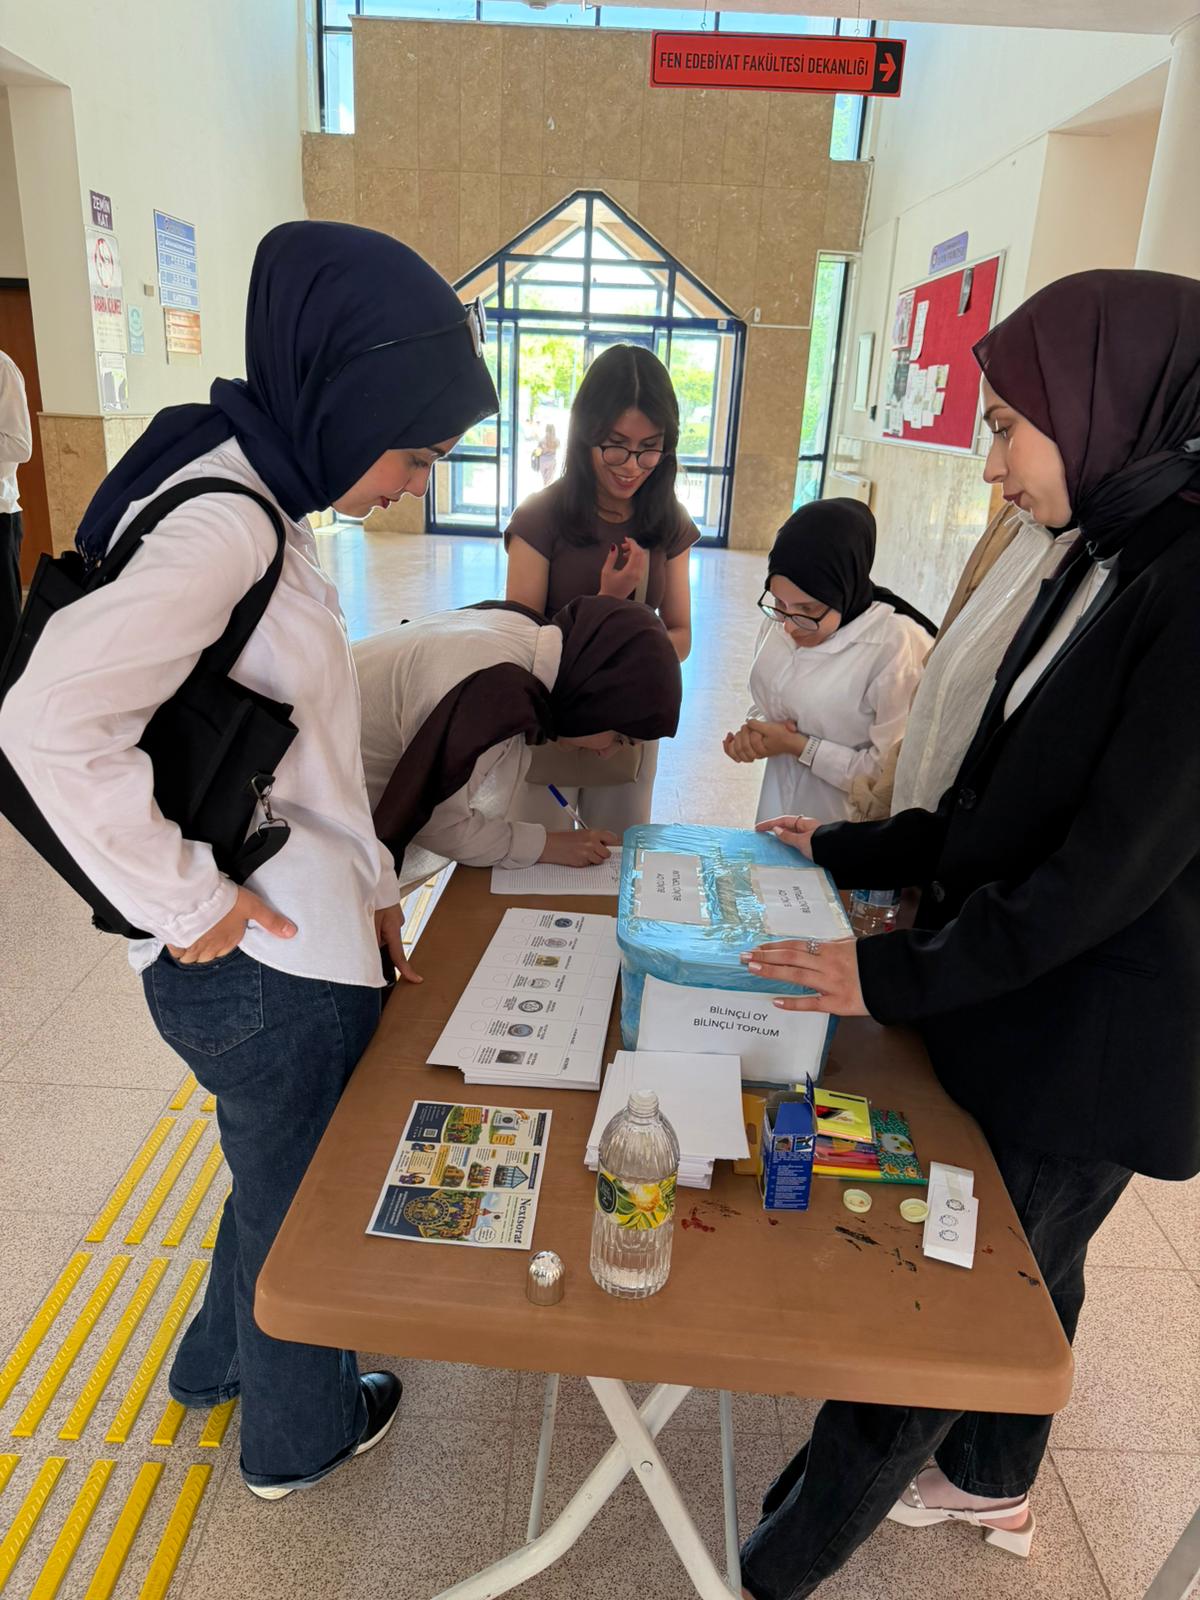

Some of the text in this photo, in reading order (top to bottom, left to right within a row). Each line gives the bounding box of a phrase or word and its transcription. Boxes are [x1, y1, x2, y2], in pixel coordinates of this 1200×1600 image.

[660, 50, 868, 76] FEN EDEBİYAT FAKÜLTESİ DEKANLIĞI
[709, 1005, 768, 1022] BİLİNÇLİ OY
[693, 1018, 780, 1038] BİLİNÇLİ TOPLUM
